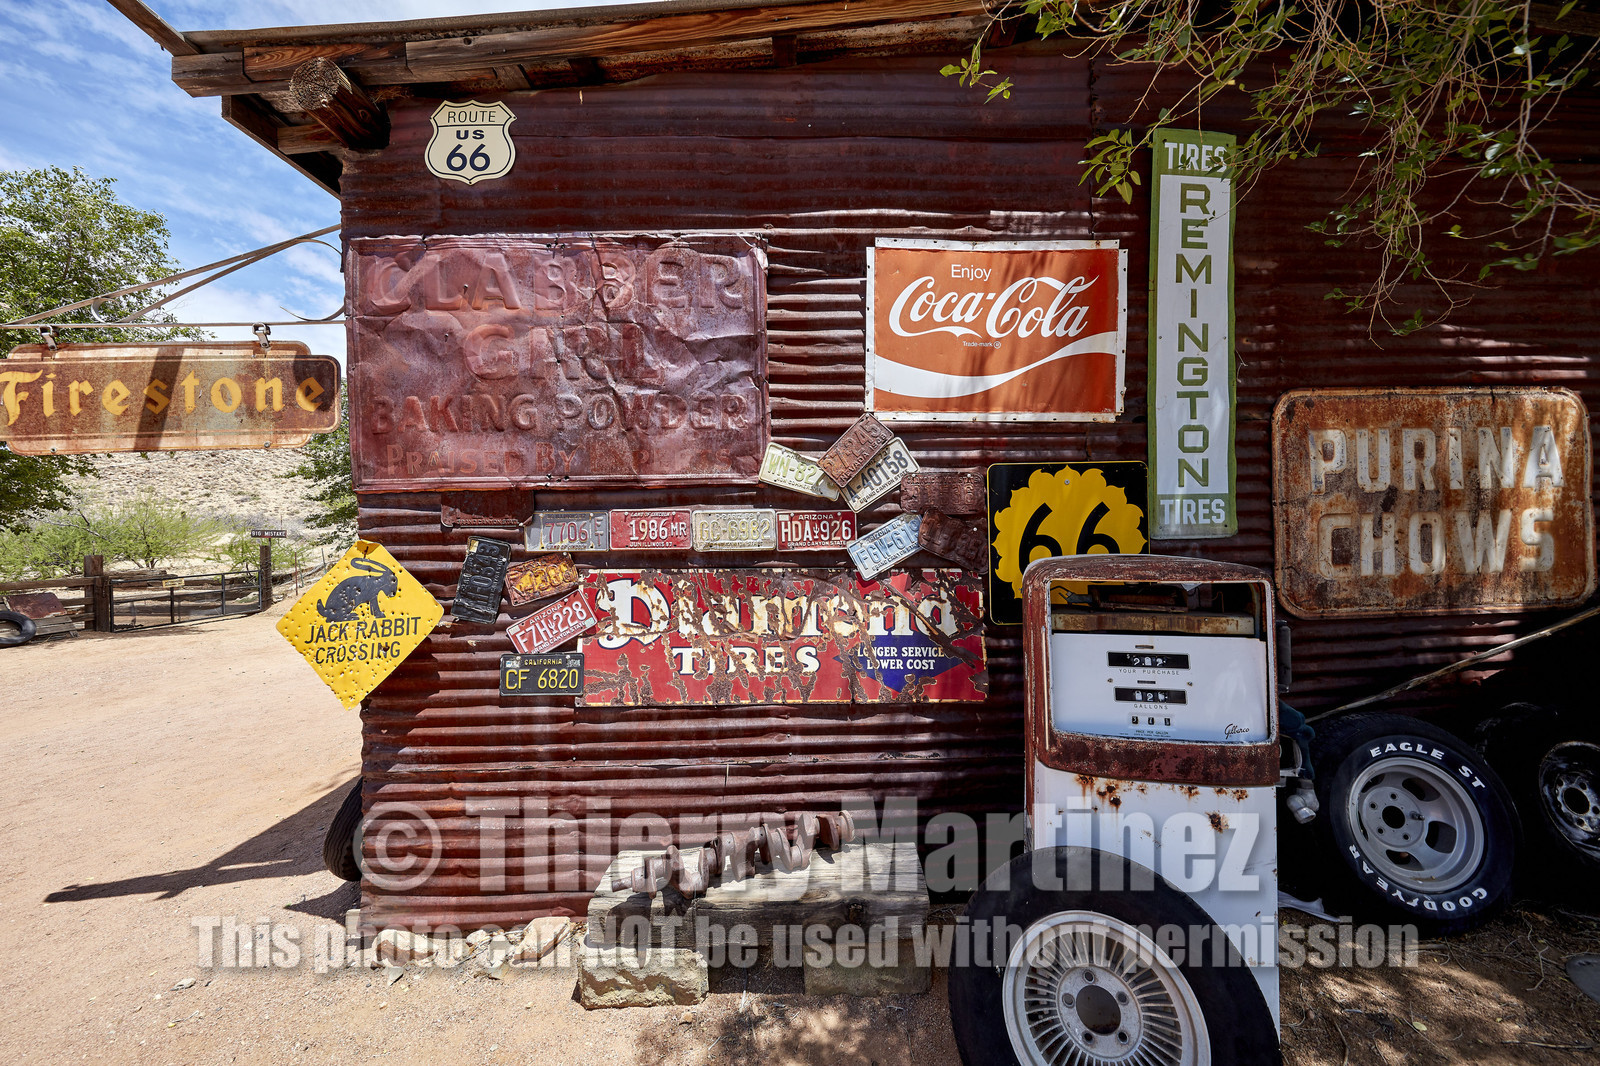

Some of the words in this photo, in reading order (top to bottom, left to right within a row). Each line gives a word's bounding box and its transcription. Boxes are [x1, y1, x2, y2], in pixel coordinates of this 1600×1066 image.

[447, 109, 497, 124] ROUTE
[456, 129, 485, 140] US
[445, 143, 491, 173] 66
[1164, 142, 1228, 173] TIRES
[366, 251, 744, 316] CLABBER
[951, 264, 992, 282] Enjoy
[889, 274, 1100, 339] Coca-Cola
[1175, 183, 1212, 487] REMINGTON
[464, 323, 665, 387] GIRL
[0, 368, 326, 428] Firestone
[369, 393, 538, 435] BAKING
[554, 391, 750, 432] POWDER
[386, 444, 523, 477] PRAISED
[535, 441, 578, 472] BY
[838, 451, 870, 483] NEVADA
[1308, 425, 1564, 495] PURINA
[846, 449, 909, 503] A-40158
[859, 488, 877, 504] GRAND
[876, 476, 897, 494] CANYON
[1160, 498, 1226, 526] TIRES
[545, 520, 589, 544] 7706
[629, 519, 668, 541] 1986
[670, 522, 687, 538] MR
[699, 518, 771, 542] GC-6982
[781, 520, 815, 542] HDA
[820, 519, 852, 542] 926
[1018, 501, 1122, 583] 66
[1318, 508, 1555, 580] CHOWS
[516, 619, 553, 653] FZH
[553, 601, 587, 633] 228
[529, 603, 563, 625] ARIZONA
[305, 622, 349, 644] JACK
[356, 616, 421, 638] RABBIT
[315, 641, 401, 665] CROSSING
[524, 658, 563, 666] CALIFORNIA
[672, 645, 821, 675] TIRES
[857, 646, 898, 657] LONGER
[901, 646, 945, 658] SERVICE
[866, 659, 904, 670] LOWER
[906, 659, 936, 670] COST
[505, 669, 530, 690] CF
[537, 668, 579, 690] 6820
[1369, 742, 1445, 761] EAGLE
[1458, 765, 1486, 789] ST
[1349, 844, 1488, 912] GOODYEAR
